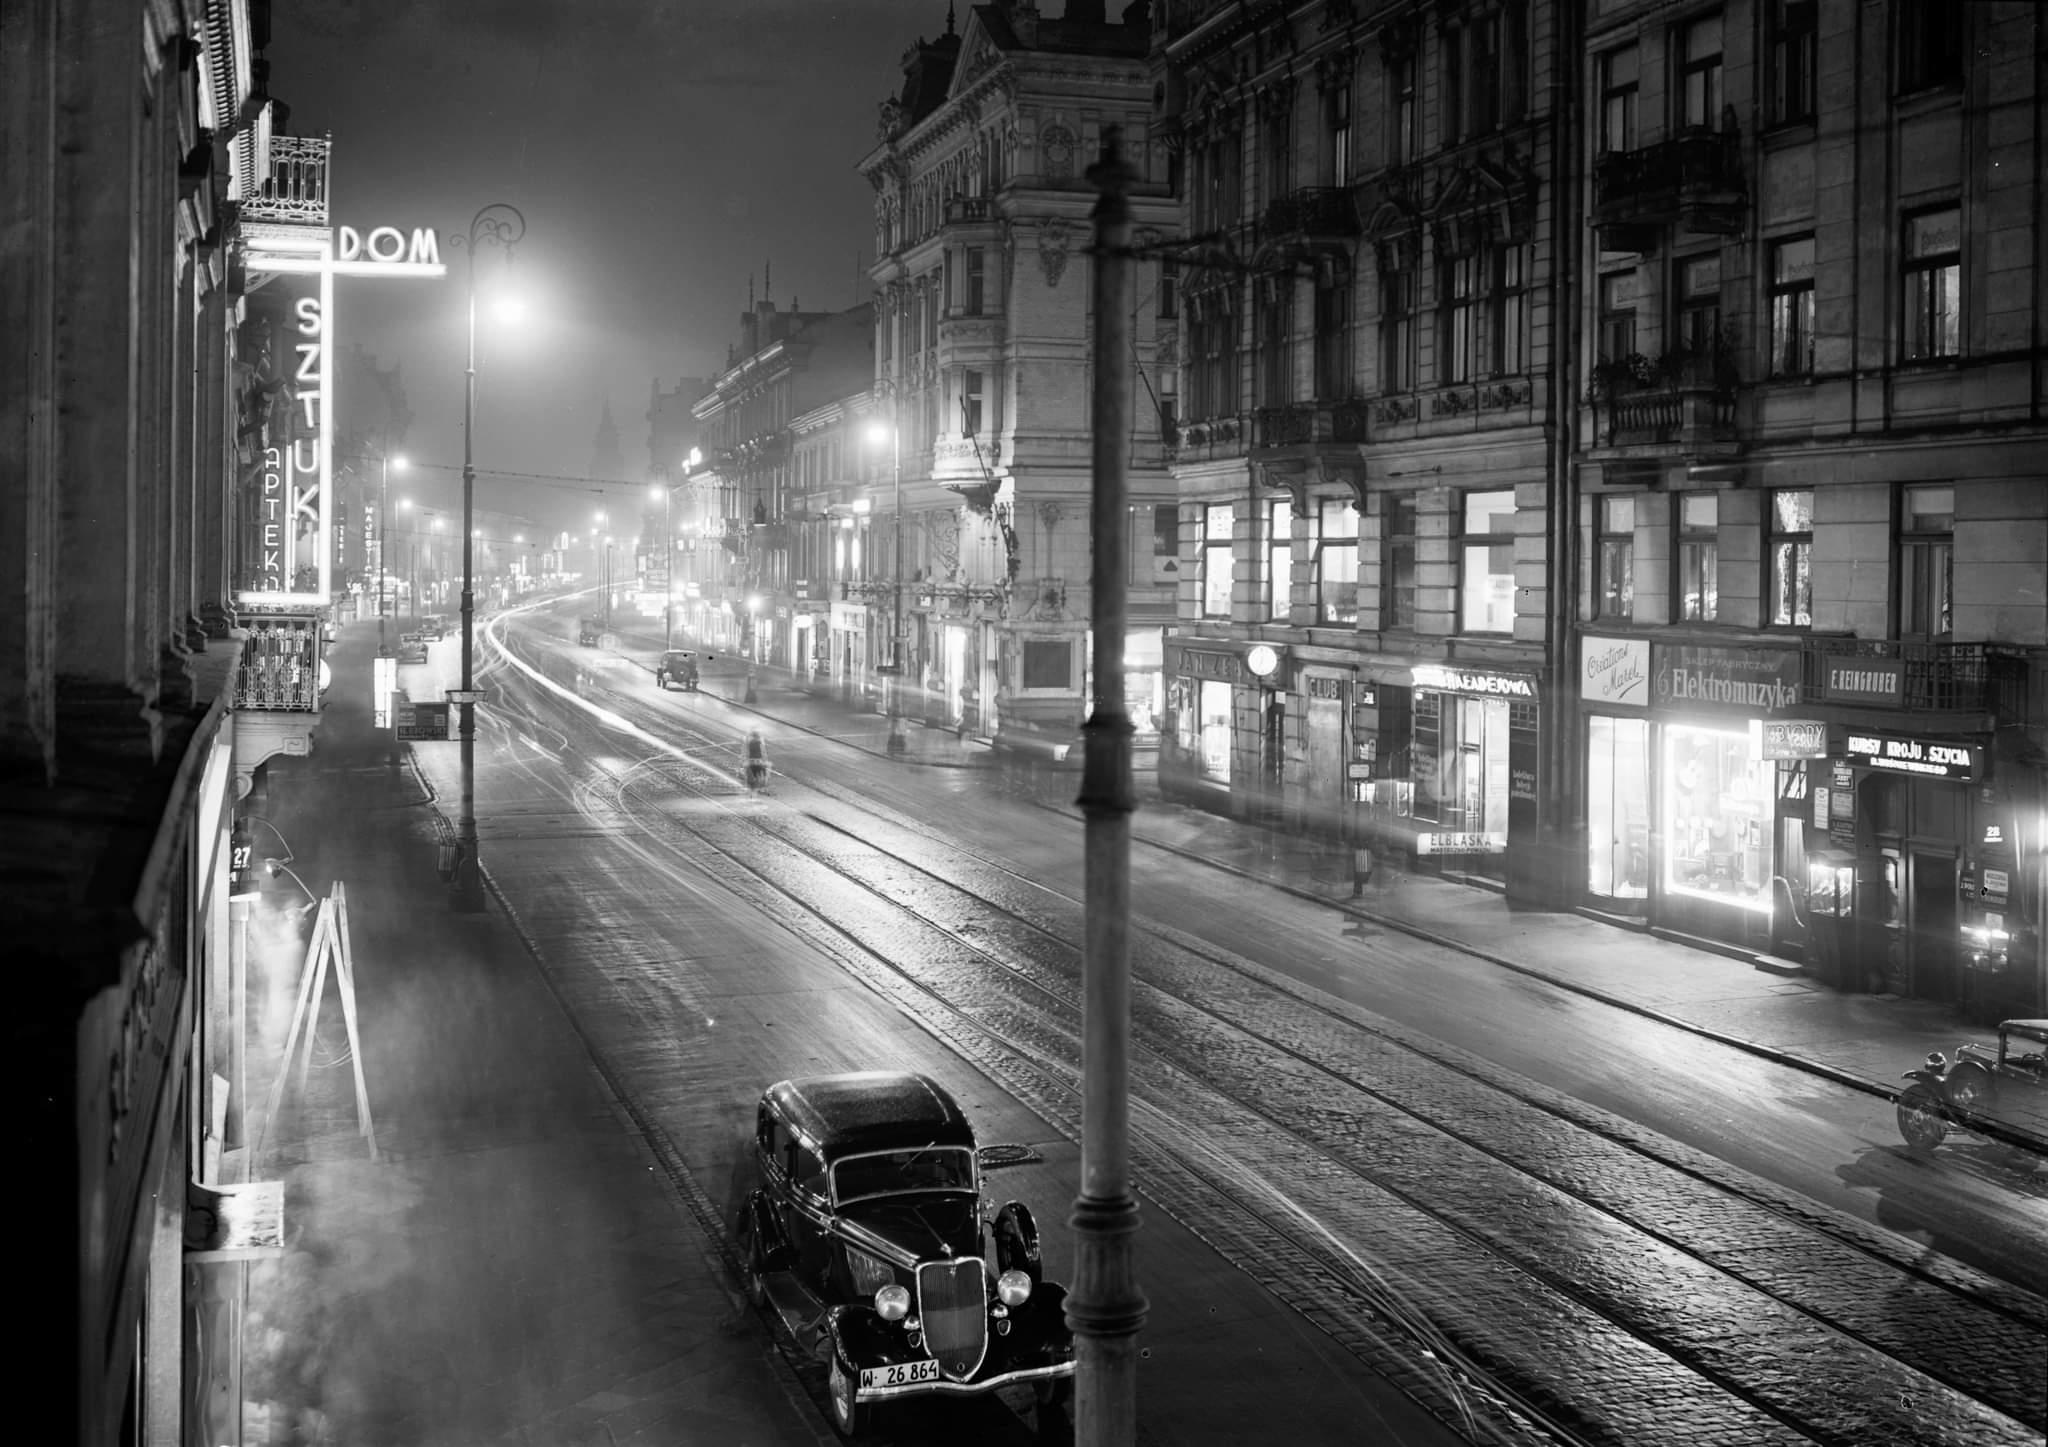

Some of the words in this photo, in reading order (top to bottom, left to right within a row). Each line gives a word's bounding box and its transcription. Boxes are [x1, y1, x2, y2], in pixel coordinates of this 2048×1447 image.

[340, 226, 440, 264] DOM
[1309, 678, 1338, 699] CLUB
[1672, 667, 1797, 714] Elektromuzyka
[1848, 737, 1881, 754] KURSY
[1929, 746, 1971, 766] SZYCIA
[233, 845, 252, 865] 27
[887, 1366, 905, 1384] 26
[910, 1361, 937, 1382] 864
